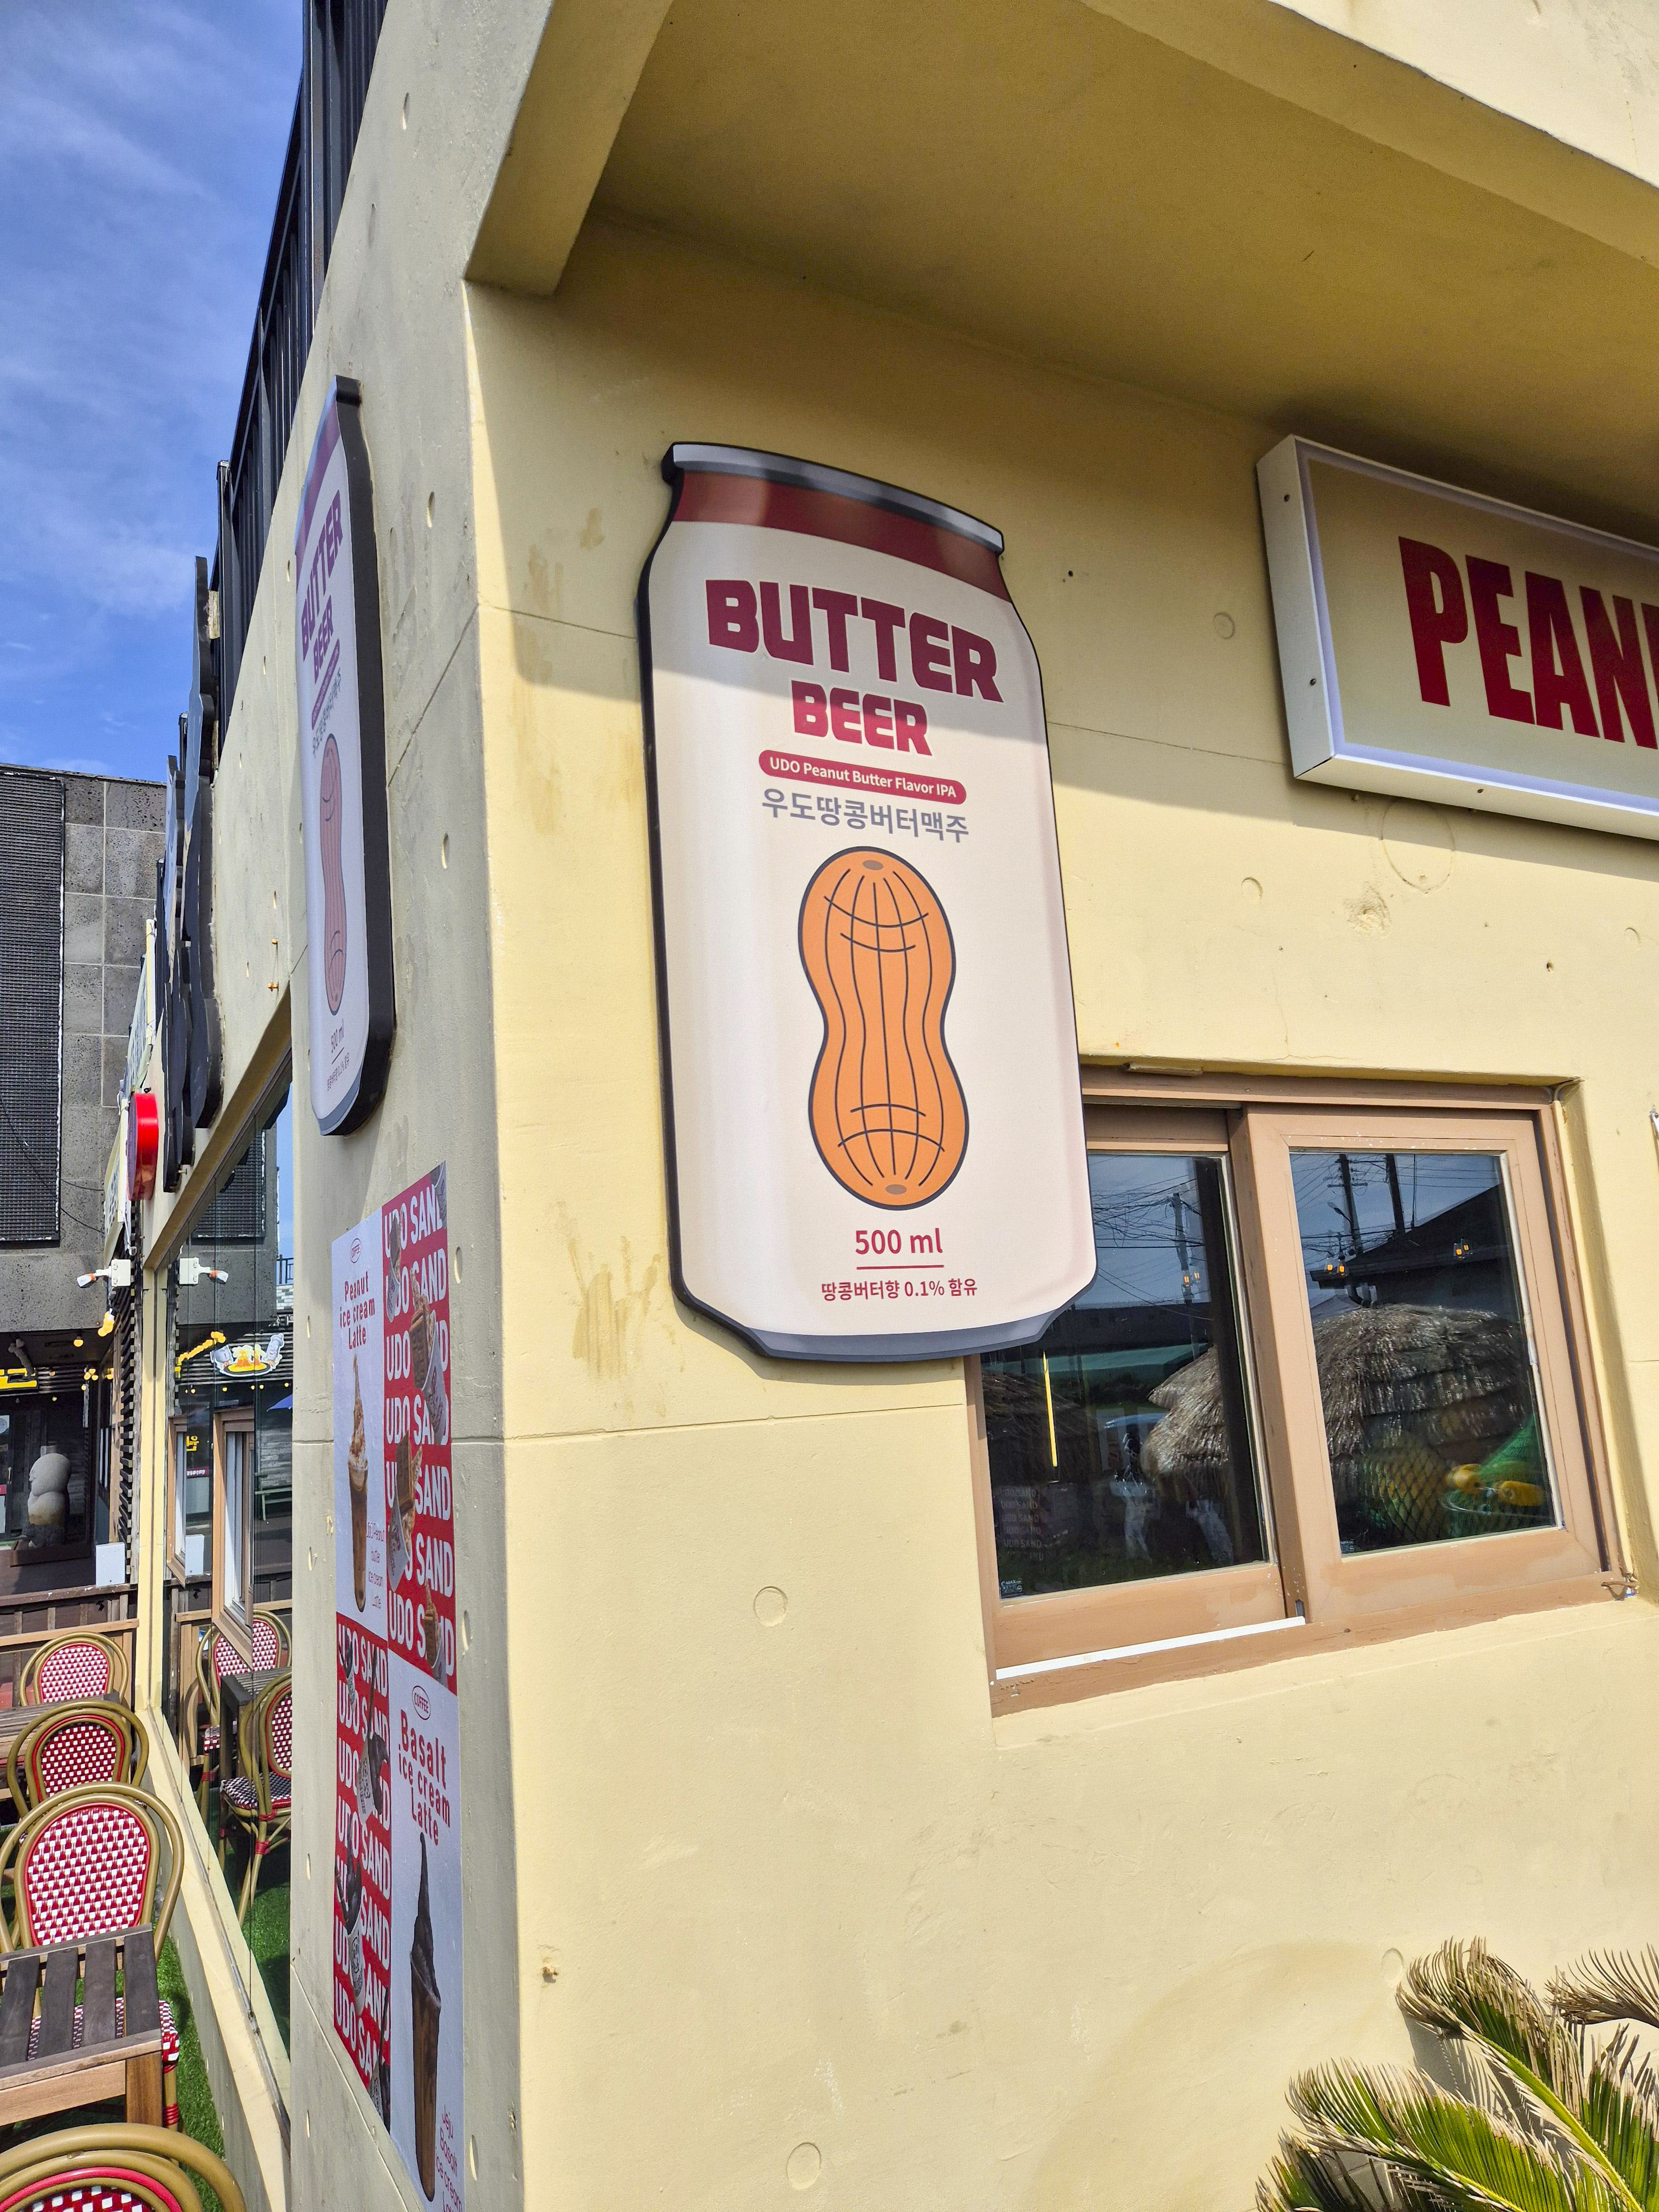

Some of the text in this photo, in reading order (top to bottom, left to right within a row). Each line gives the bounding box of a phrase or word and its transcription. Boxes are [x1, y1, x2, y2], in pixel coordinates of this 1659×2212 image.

[301, 489, 343, 661] BUTTER
[314, 595, 333, 685] BEER
[706, 580, 1004, 703] BUTTER
[791, 680, 932, 756] BEER
[769, 756, 957, 798] UDO Peanut Butter Flavor IPA
[762, 788, 969, 843] 우도땅콩버터맥주
[855, 1228, 943, 1255] 500 ml
[340, 1297, 375, 1328] ice cream
[345, 1271, 369, 1301] Peanut
[821, 1278, 978, 1301] 땅콩버터향 0.1% 함유
[348, 1324, 367, 1350] Latte
[387, 1331, 410, 1381] UDO
[386, 1395, 410, 1444] UDO
[416, 1533, 453, 1598] SAND
[389, 1590, 454, 1676] UDO SD
[414, 1692, 429, 1714] COFFEE
[338, 1738, 359, 1796] UDO
[401, 1709, 446, 1790] Basalt
[398, 1744, 451, 1828] ice cream
[411, 1786, 439, 1846] Latte
[361, 1823, 390, 1900] SAND
[361, 1886, 390, 1970] SAND
[335, 1914, 353, 1986] UD
[364, 1960, 390, 2042] AND
[335, 1976, 357, 2052] UDO
